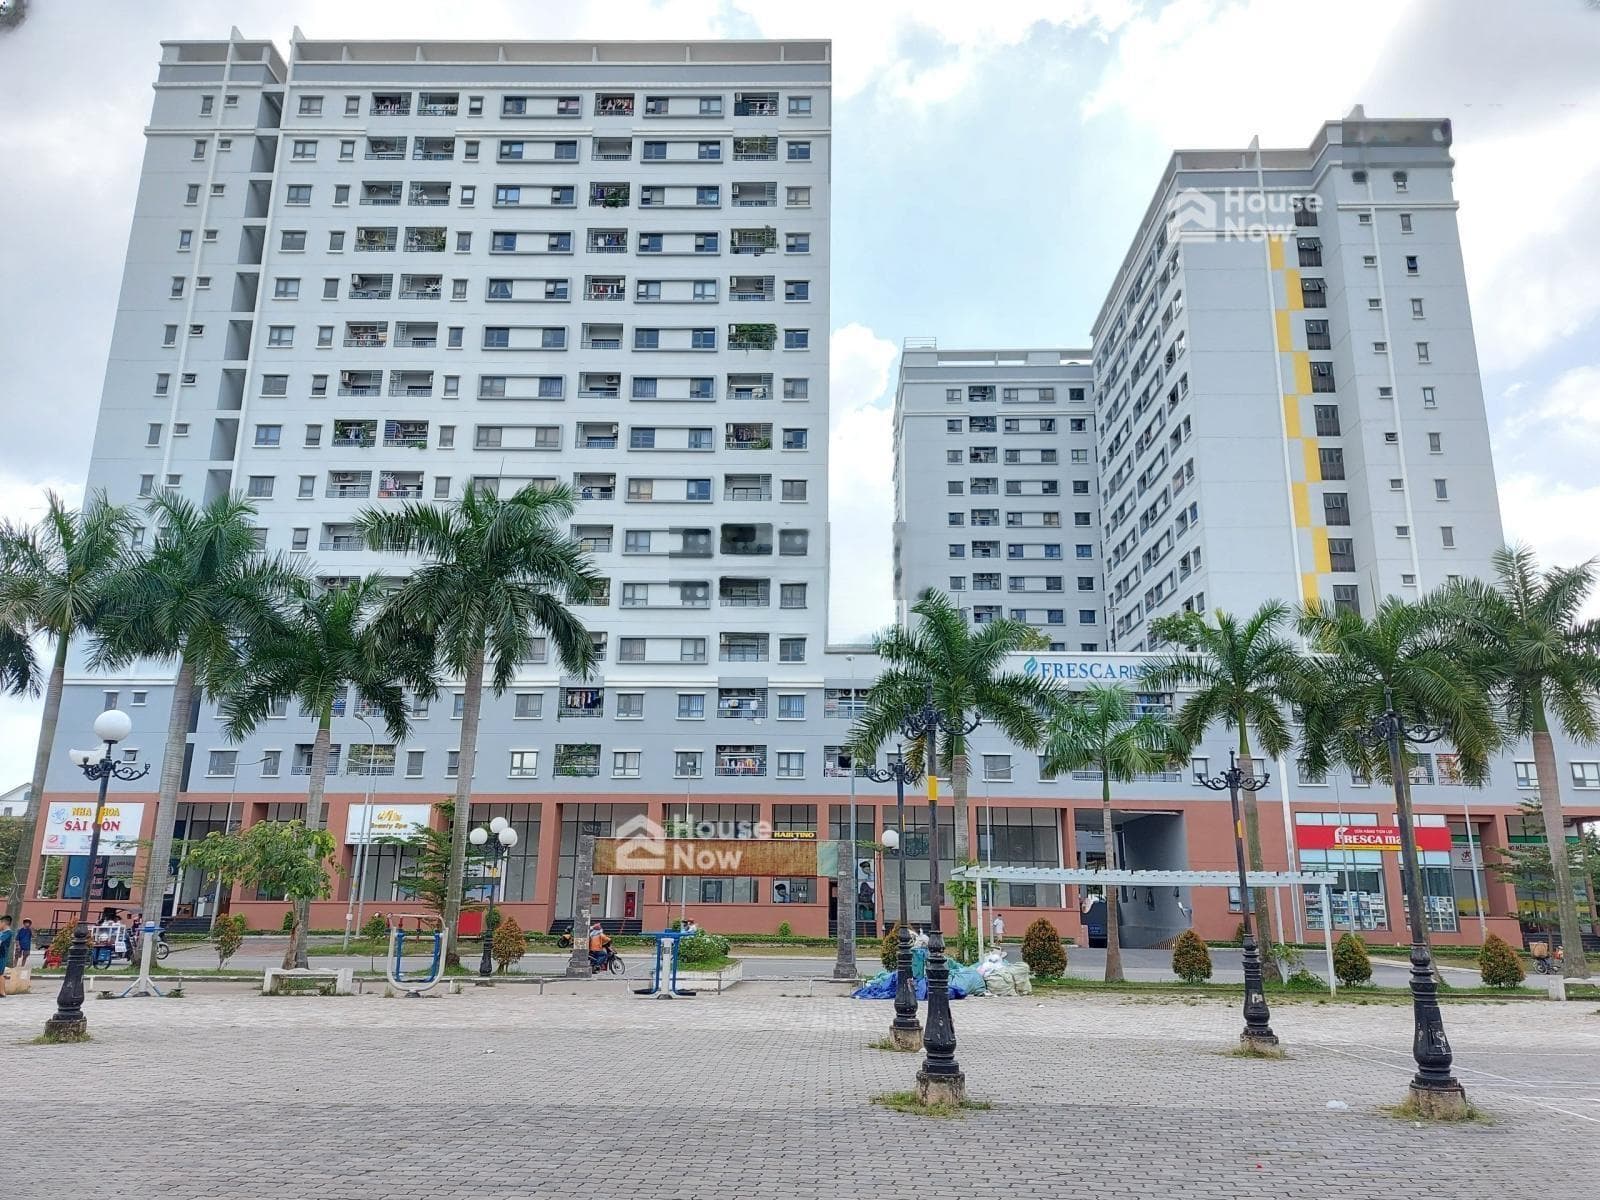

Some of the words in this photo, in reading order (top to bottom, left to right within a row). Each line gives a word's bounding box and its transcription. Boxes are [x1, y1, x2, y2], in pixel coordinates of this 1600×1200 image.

[1041, 662, 1117, 679] FRESCA
[1334, 827, 1383, 844] FRESCA
[1385, 836, 1402, 845] ma
